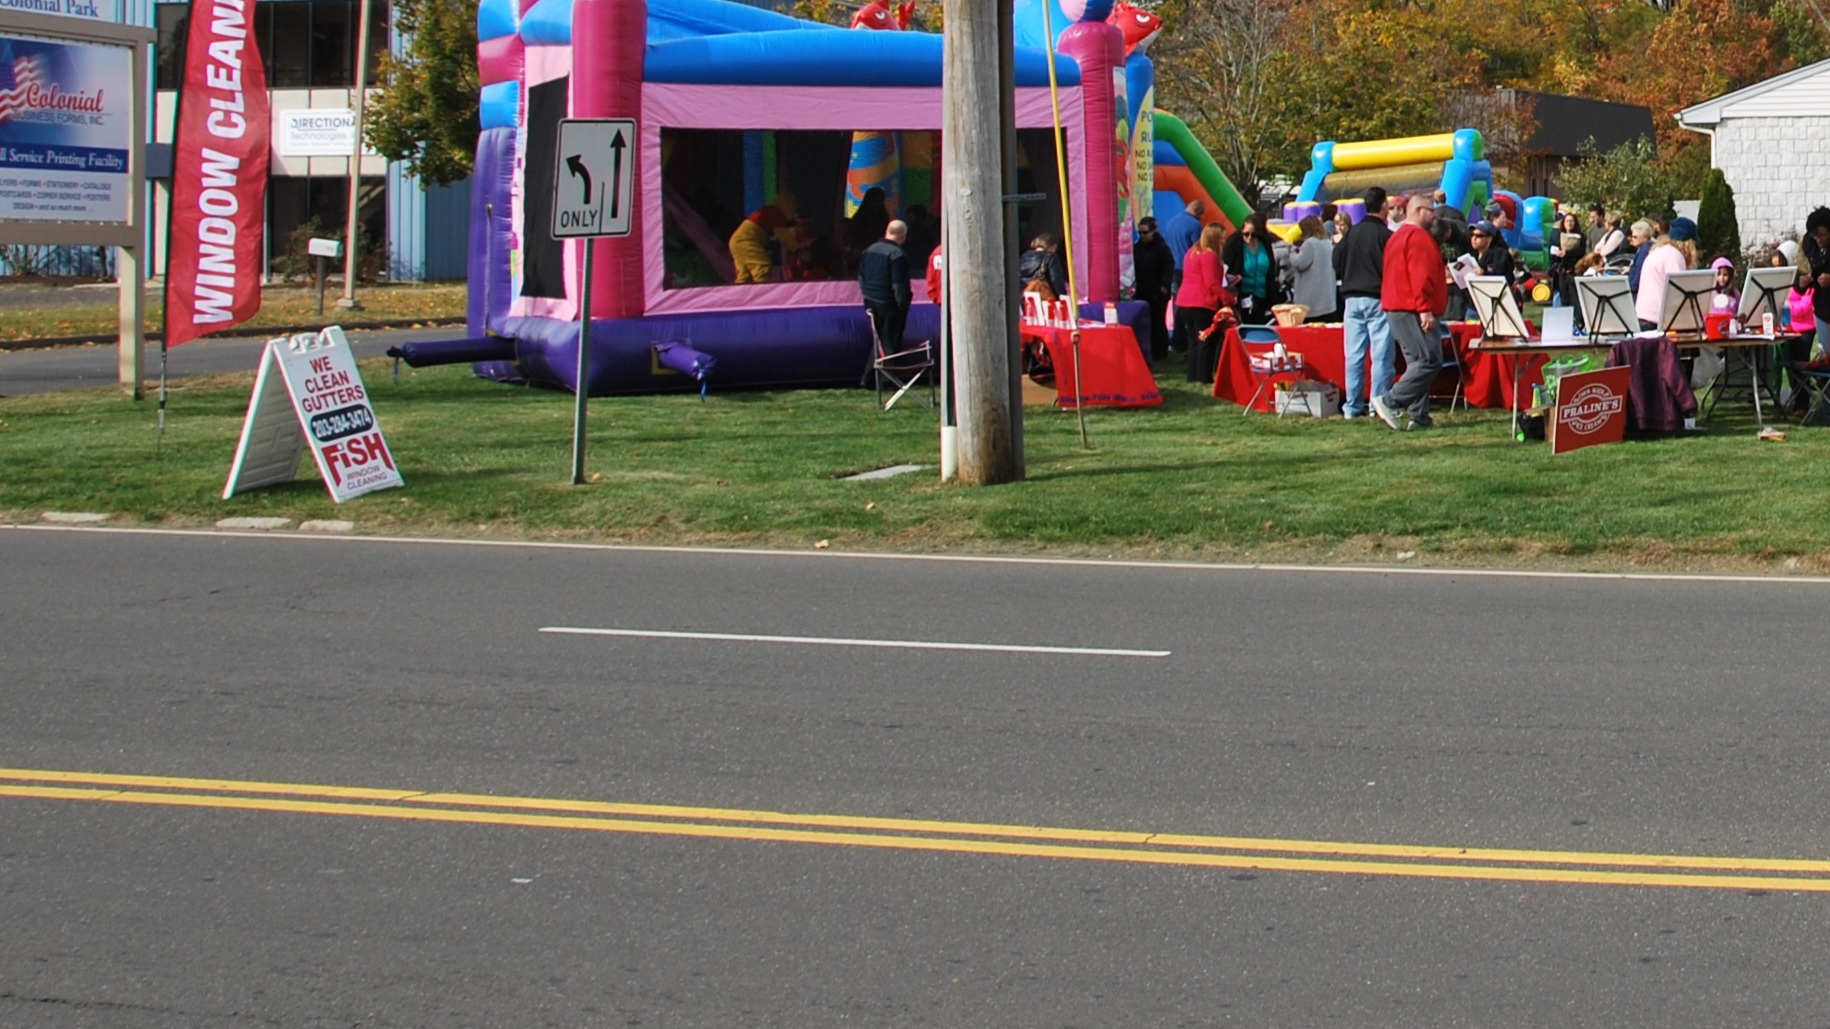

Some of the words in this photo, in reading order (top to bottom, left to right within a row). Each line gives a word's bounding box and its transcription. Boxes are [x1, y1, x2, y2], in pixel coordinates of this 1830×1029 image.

[26, 82, 104, 112] Colonial
[15, 110, 55, 123] BUSINESS
[291, 117, 356, 128] DIRECTIONA
[1140, 110, 1153, 123] PO
[1140, 131, 1153, 143] RU
[9, 148, 44, 164] Service
[46, 150, 86, 168] Printing
[88, 152, 124, 170] Facility
[560, 209, 599, 228] ONLY
[193, 148, 240, 325] WINDOW
[309, 356, 333, 373] WE
[304, 370, 350, 394] CLEAN
[302, 385, 365, 413] GUTTERS
[1563, 399, 1619, 419] PRALINE'S
[346, 464, 380, 481] WINDOW
[347, 471, 388, 490] CLEANING
